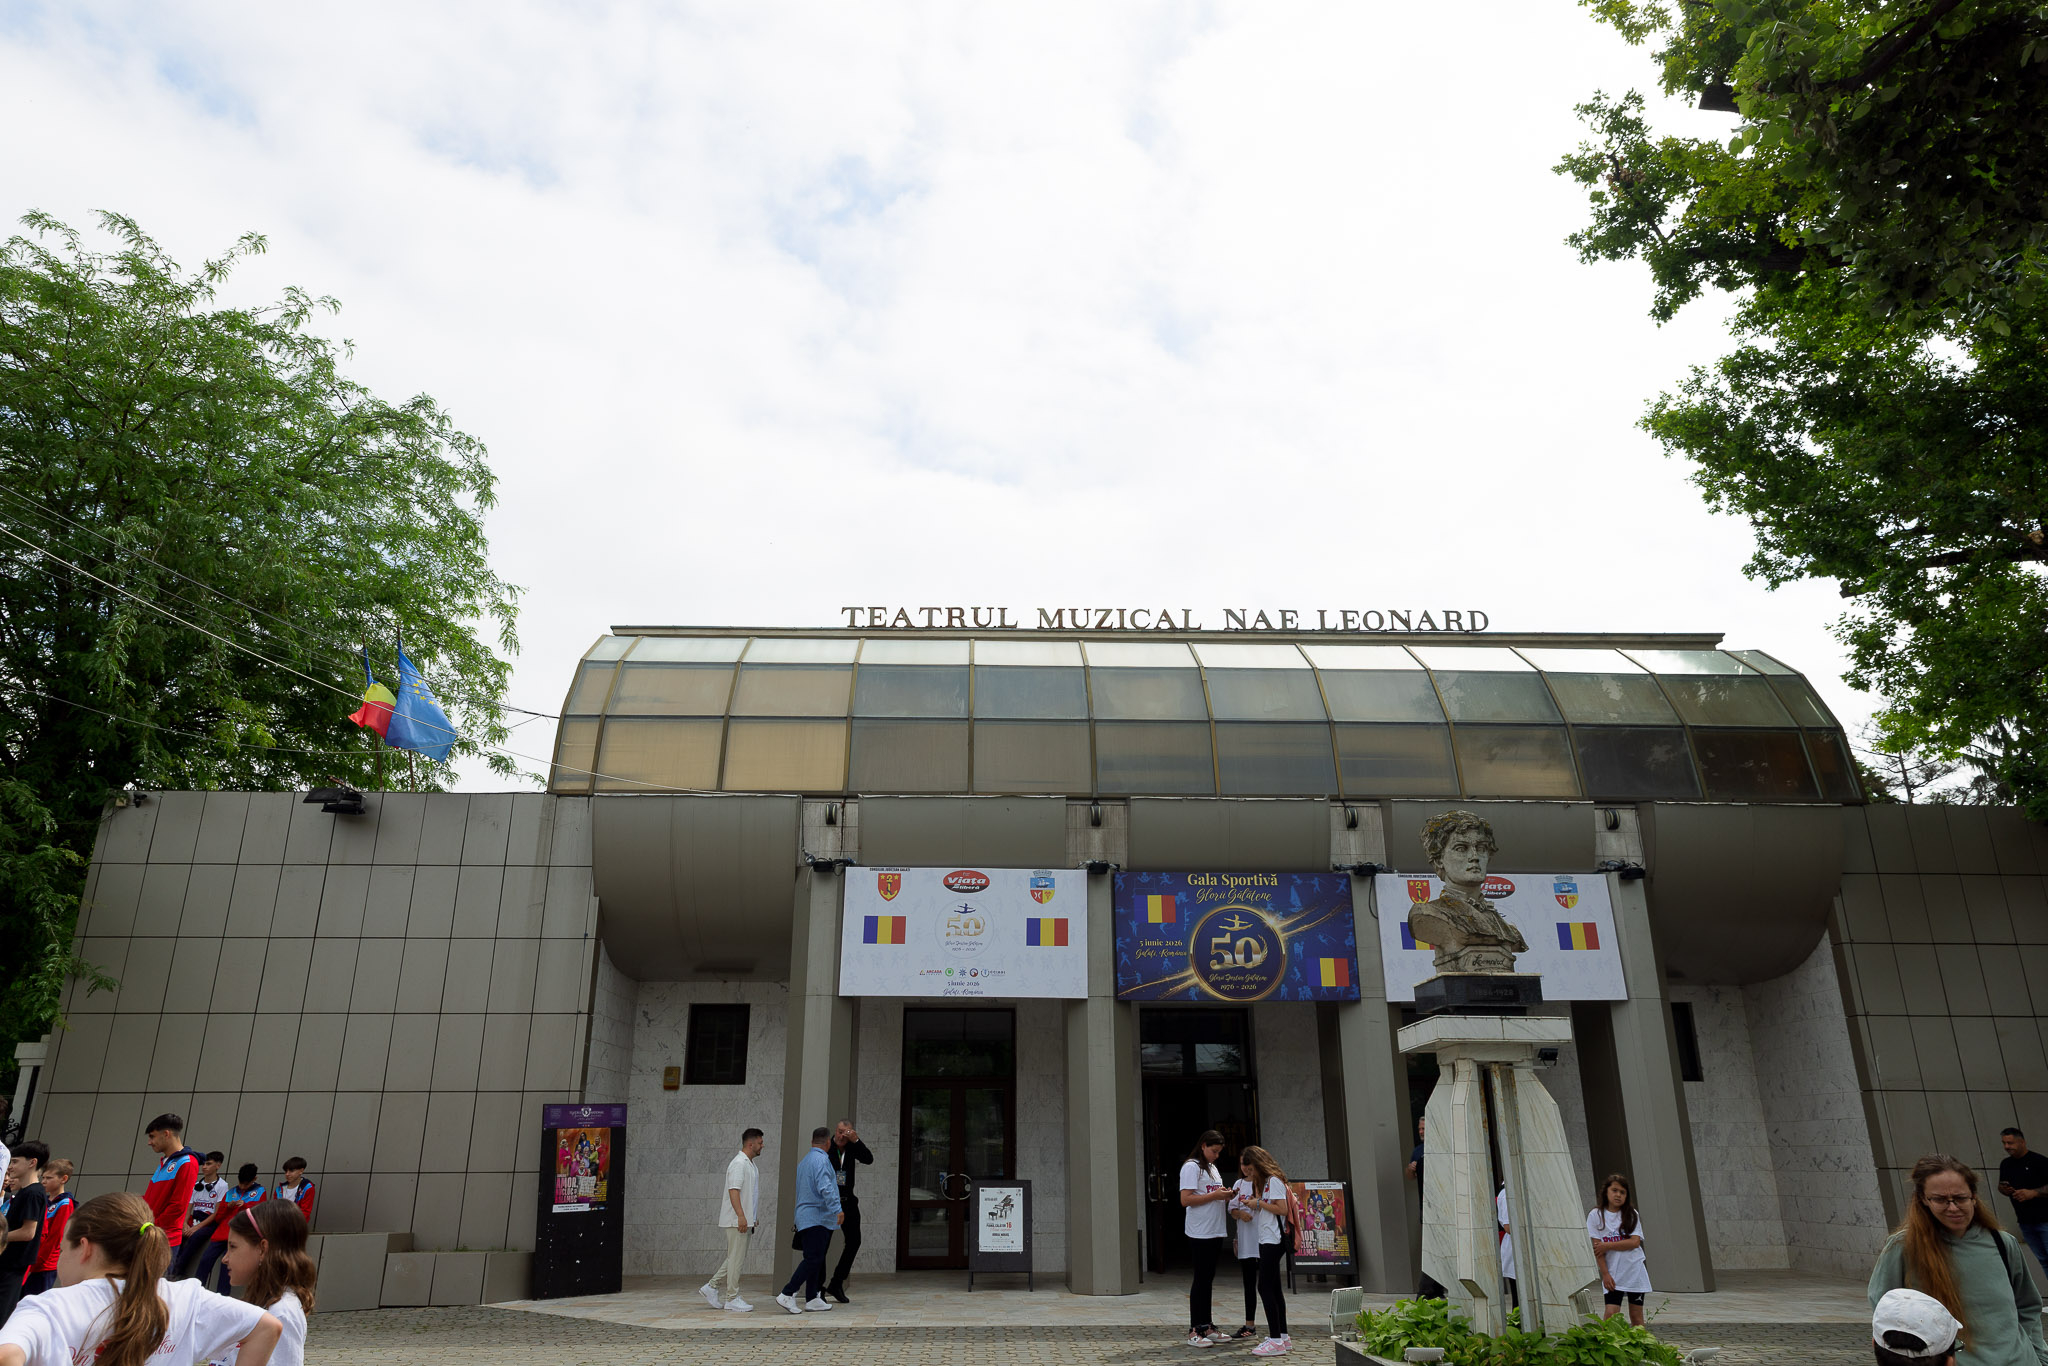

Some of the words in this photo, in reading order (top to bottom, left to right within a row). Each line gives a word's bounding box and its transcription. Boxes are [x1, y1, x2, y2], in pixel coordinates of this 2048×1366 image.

[841, 606, 1019, 630] TEATRUL
[1036, 606, 1202, 631] MUZICAL
[1223, 607, 1300, 632] NAE
[1316, 608, 1490, 633] LEONARD
[1187, 873, 1218, 886] Gala
[1221, 873, 1279, 888] Sportivă
[945, 914, 985, 937] 50
[1144, 938, 1164, 946] iunie
[1210, 932, 1266, 970] 50
